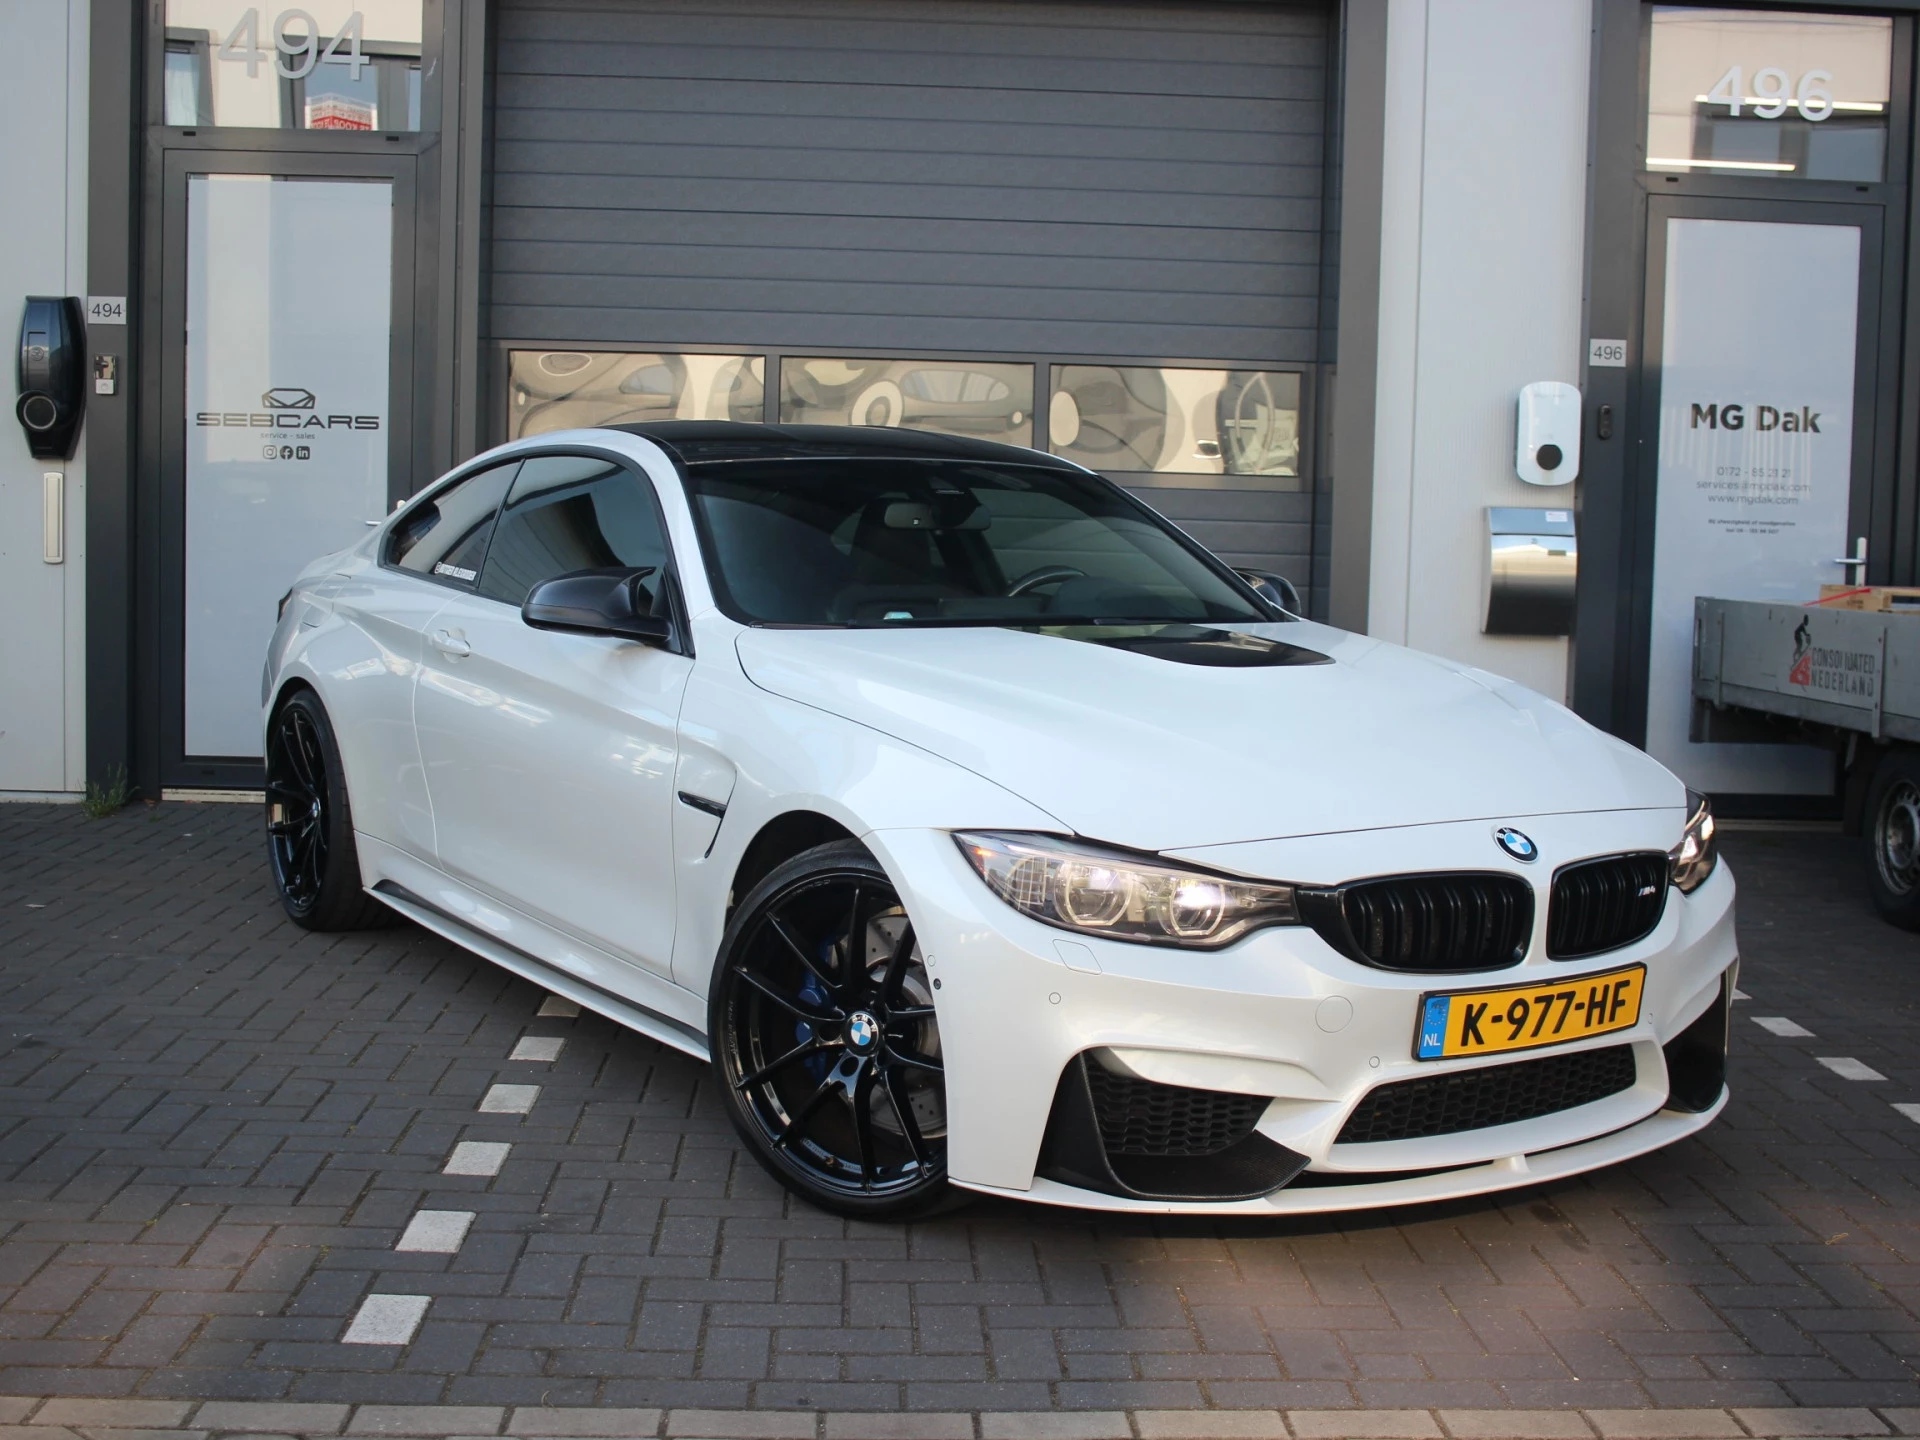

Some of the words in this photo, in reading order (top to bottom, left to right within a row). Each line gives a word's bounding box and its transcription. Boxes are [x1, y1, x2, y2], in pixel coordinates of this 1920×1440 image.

[218, 7, 370, 81] 494
[1706, 64, 1834, 122] 496
[91, 302, 123, 318] 494
[1593, 345, 1623, 361] 496
[196, 412, 380, 430] SEBCARS
[1690, 403, 1745, 431] MG
[1755, 405, 1822, 433] Dak
[260, 431, 288, 439] service
[296, 431, 316, 440] sales
[1716, 466, 1741, 477] 0172
[1708, 494, 1799, 505] www.mgdak.com
[1810, 668, 1875, 698] NEDERLAND
[1460, 979, 1631, 1047] K-977-HF
[1423, 1032, 1441, 1047] NL
